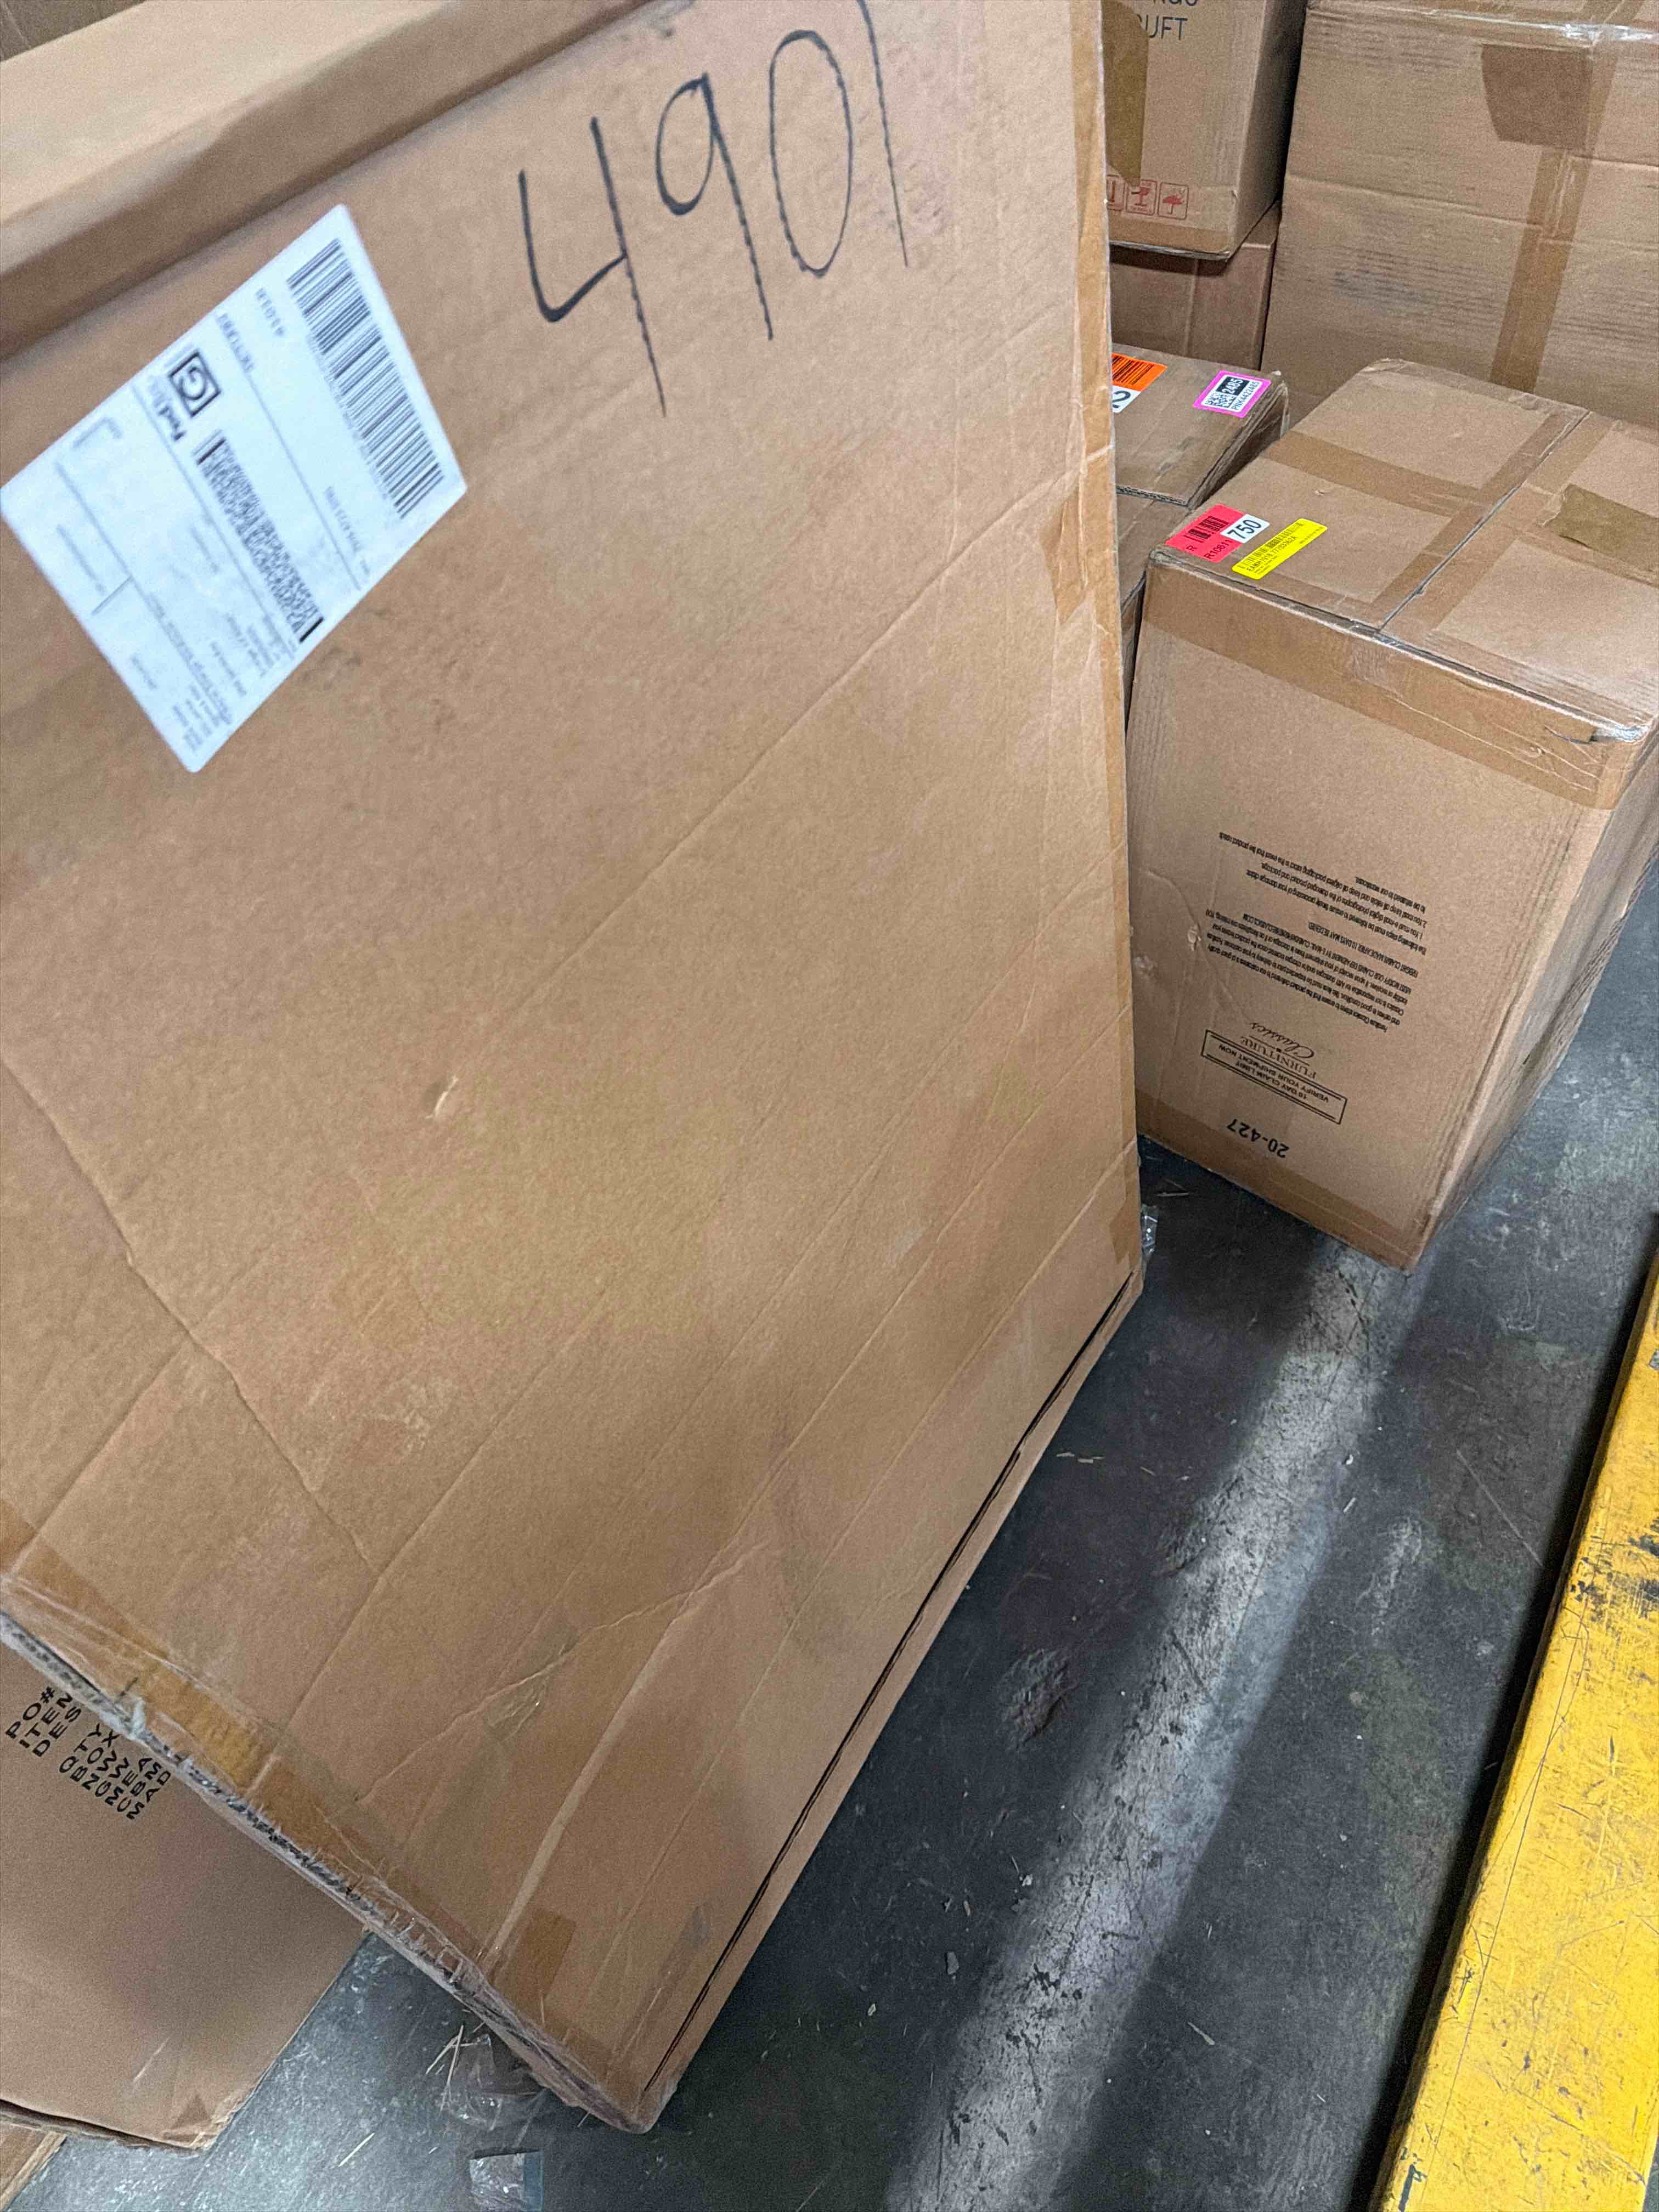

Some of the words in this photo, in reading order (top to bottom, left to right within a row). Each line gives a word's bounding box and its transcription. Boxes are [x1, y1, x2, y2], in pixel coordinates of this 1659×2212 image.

[517, 0, 909, 418] 4901
[1221, 378, 1243, 394] 2485
[1227, 519, 1262, 540] 750
[1218, 1044, 1237, 1056] NOW
[1240, 1036, 1317, 1080] FURNITURE
[1250, 1022, 1314, 1059] Classics
[1239, 1053, 1278, 1077] SHIPMENT
[1254, 1070, 1280, 1085] CLAIM
[1278, 1074, 1299, 1087] YOUR
[1281, 1083, 1297, 1094] DAY
[1300, 1085, 1329, 1103] VERIFY
[1227, 1119, 1289, 1159] 20-427
[5, 1686, 55, 1739] PO#
[32, 1707, 81, 1757] DES
[59, 1723, 101, 1773] QTY
[70, 1729, 120, 1782] BOX
[105, 1757, 153, 1805] MEA
[117, 1762, 162, 1812] CBM
[127, 1771, 171, 1820] MAD
